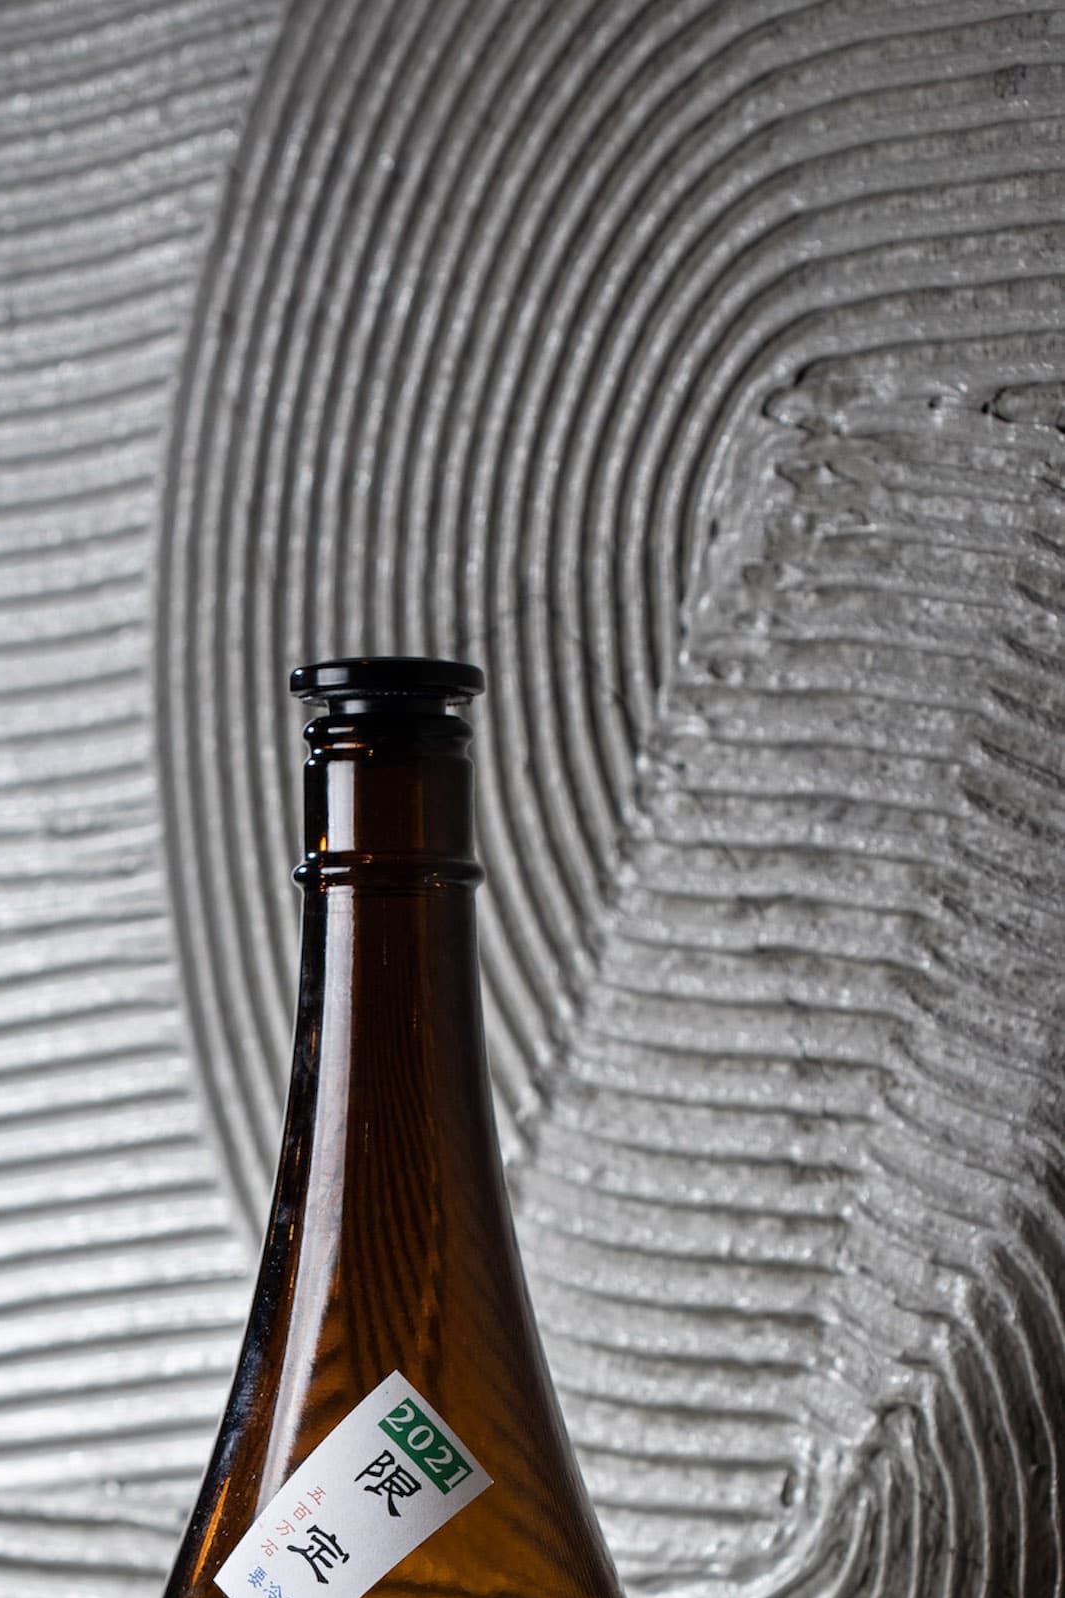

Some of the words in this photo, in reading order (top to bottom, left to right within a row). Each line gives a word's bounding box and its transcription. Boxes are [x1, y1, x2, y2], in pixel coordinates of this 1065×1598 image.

[384, 1404, 468, 1490] 2021
[260, 1487, 326, 1558] 五百万石
[286, 1449, 423, 1585] 限定
